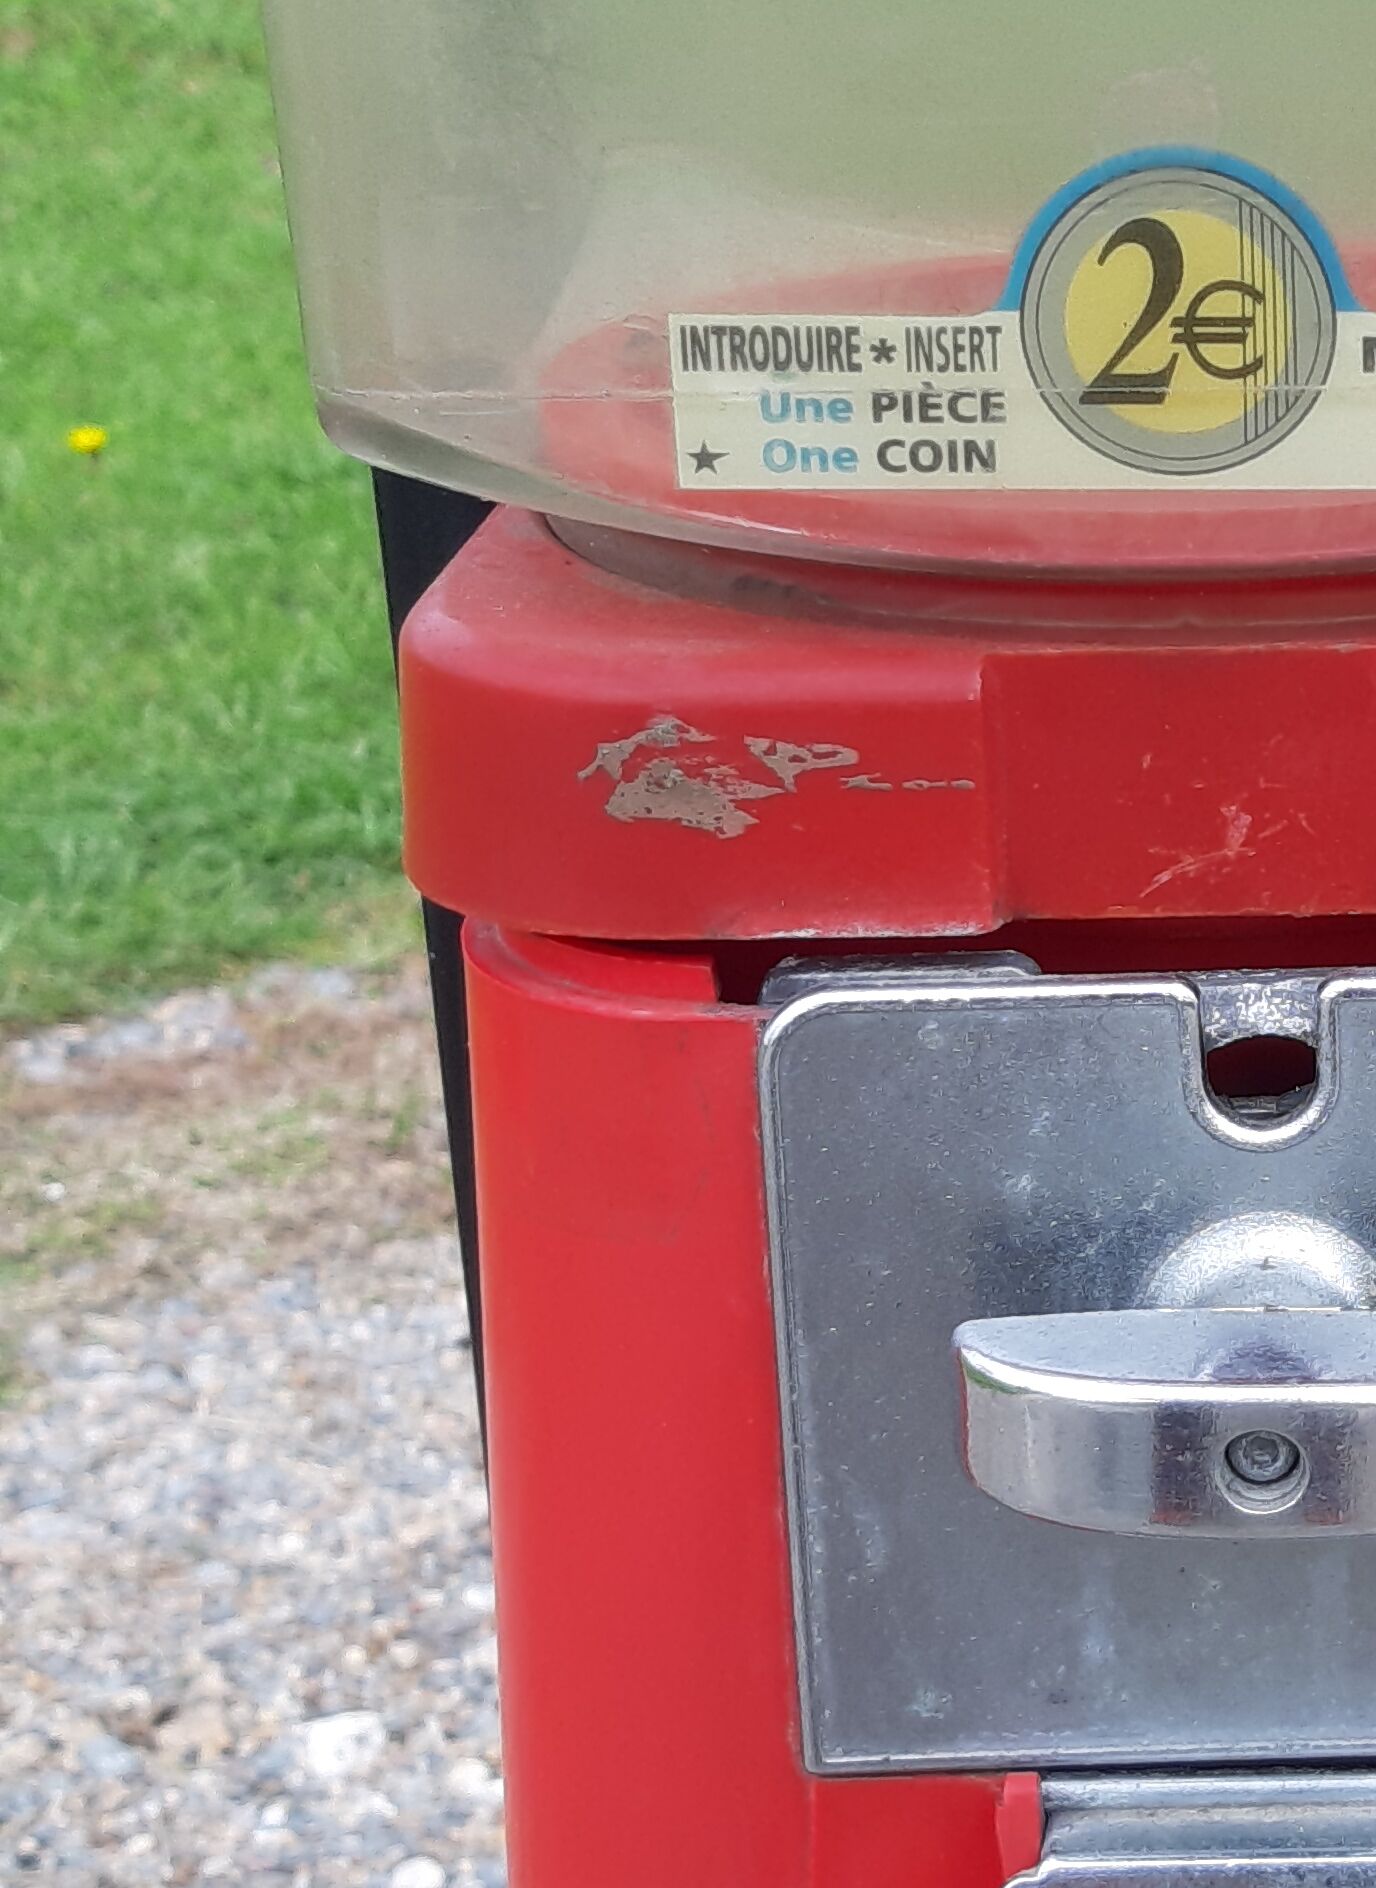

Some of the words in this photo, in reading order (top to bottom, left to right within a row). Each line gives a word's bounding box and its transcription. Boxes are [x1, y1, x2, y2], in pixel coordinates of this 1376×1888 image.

[1079, 217, 1264, 405] 2€
[679, 325, 863, 373] INTRODUIRE
[904, 325, 1003, 373] INSERT
[760, 390, 854, 424] Une
[871, 381, 1007, 424] PIÈCE
[762, 438, 858, 473] One
[876, 438, 997, 474] COIN
